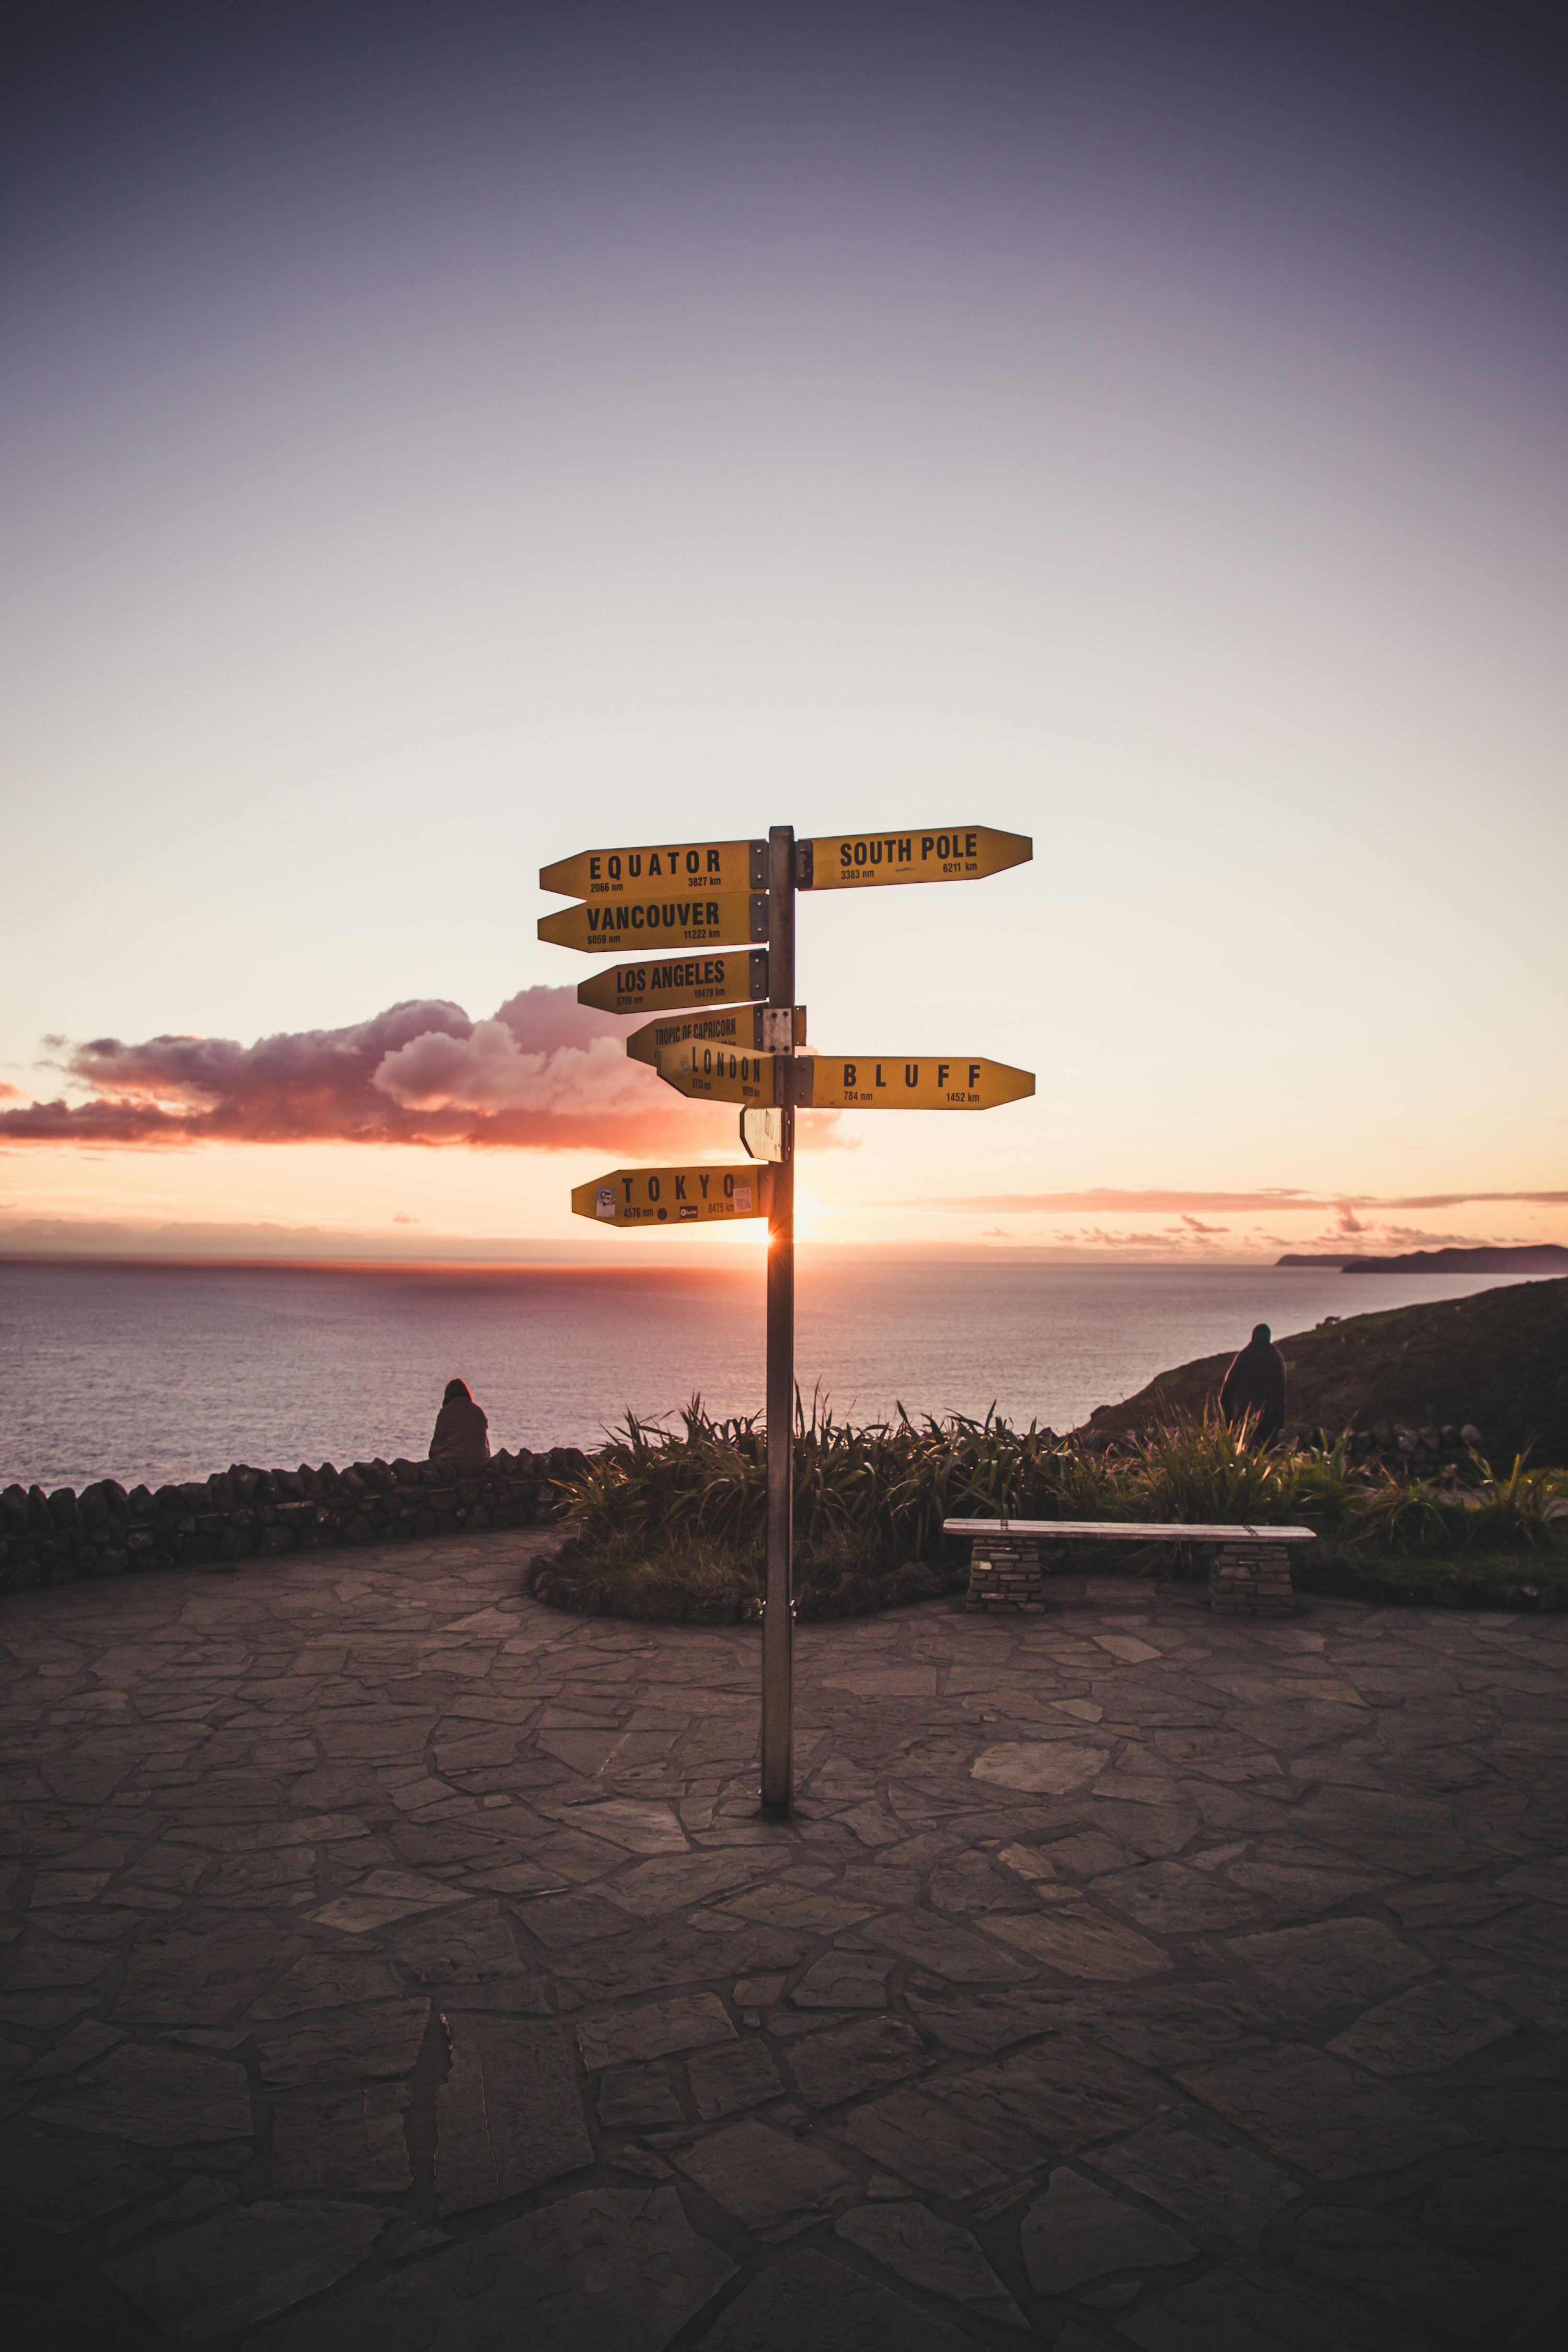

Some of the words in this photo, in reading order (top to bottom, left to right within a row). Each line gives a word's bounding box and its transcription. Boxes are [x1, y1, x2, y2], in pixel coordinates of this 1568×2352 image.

[840, 838, 911, 867] SOUTH
[922, 834, 977, 860] POLE
[590, 850, 720, 881] EQUATOR
[943, 863, 961, 873] 6211
[965, 862, 977, 871] km
[841, 870, 860, 880] 3383
[688, 877, 707, 887] 3827
[710, 877, 721, 885] km
[591, 883, 609, 893] 2066
[587, 902, 719, 931] VANCOUVER
[587, 935, 606, 944] 6059
[684, 929, 706, 939] 11222
[709, 929, 720, 938] km
[617, 969, 646, 993] LOS
[651, 960, 724, 989] ANGELES
[694, 988, 713, 998] 10479
[715, 987, 725, 996] km
[617, 996, 632, 1006] 5709
[655, 1026, 681, 1045] TROPIC
[683, 1024, 691, 1040] OF
[694, 1018, 736, 1039] CAPRICORN
[693, 1046, 760, 1083] LONDON
[844, 1064, 980, 1087] BLUFF
[844, 1091, 858, 1100] 784
[946, 1093, 965, 1102] 1452
[968, 1092, 979, 1102] km
[622, 1173, 734, 1203] TOKYO
[624, 1207, 641, 1218] 4576
[709, 1204, 723, 1213] 8475
[726, 1203, 734, 1212] km
